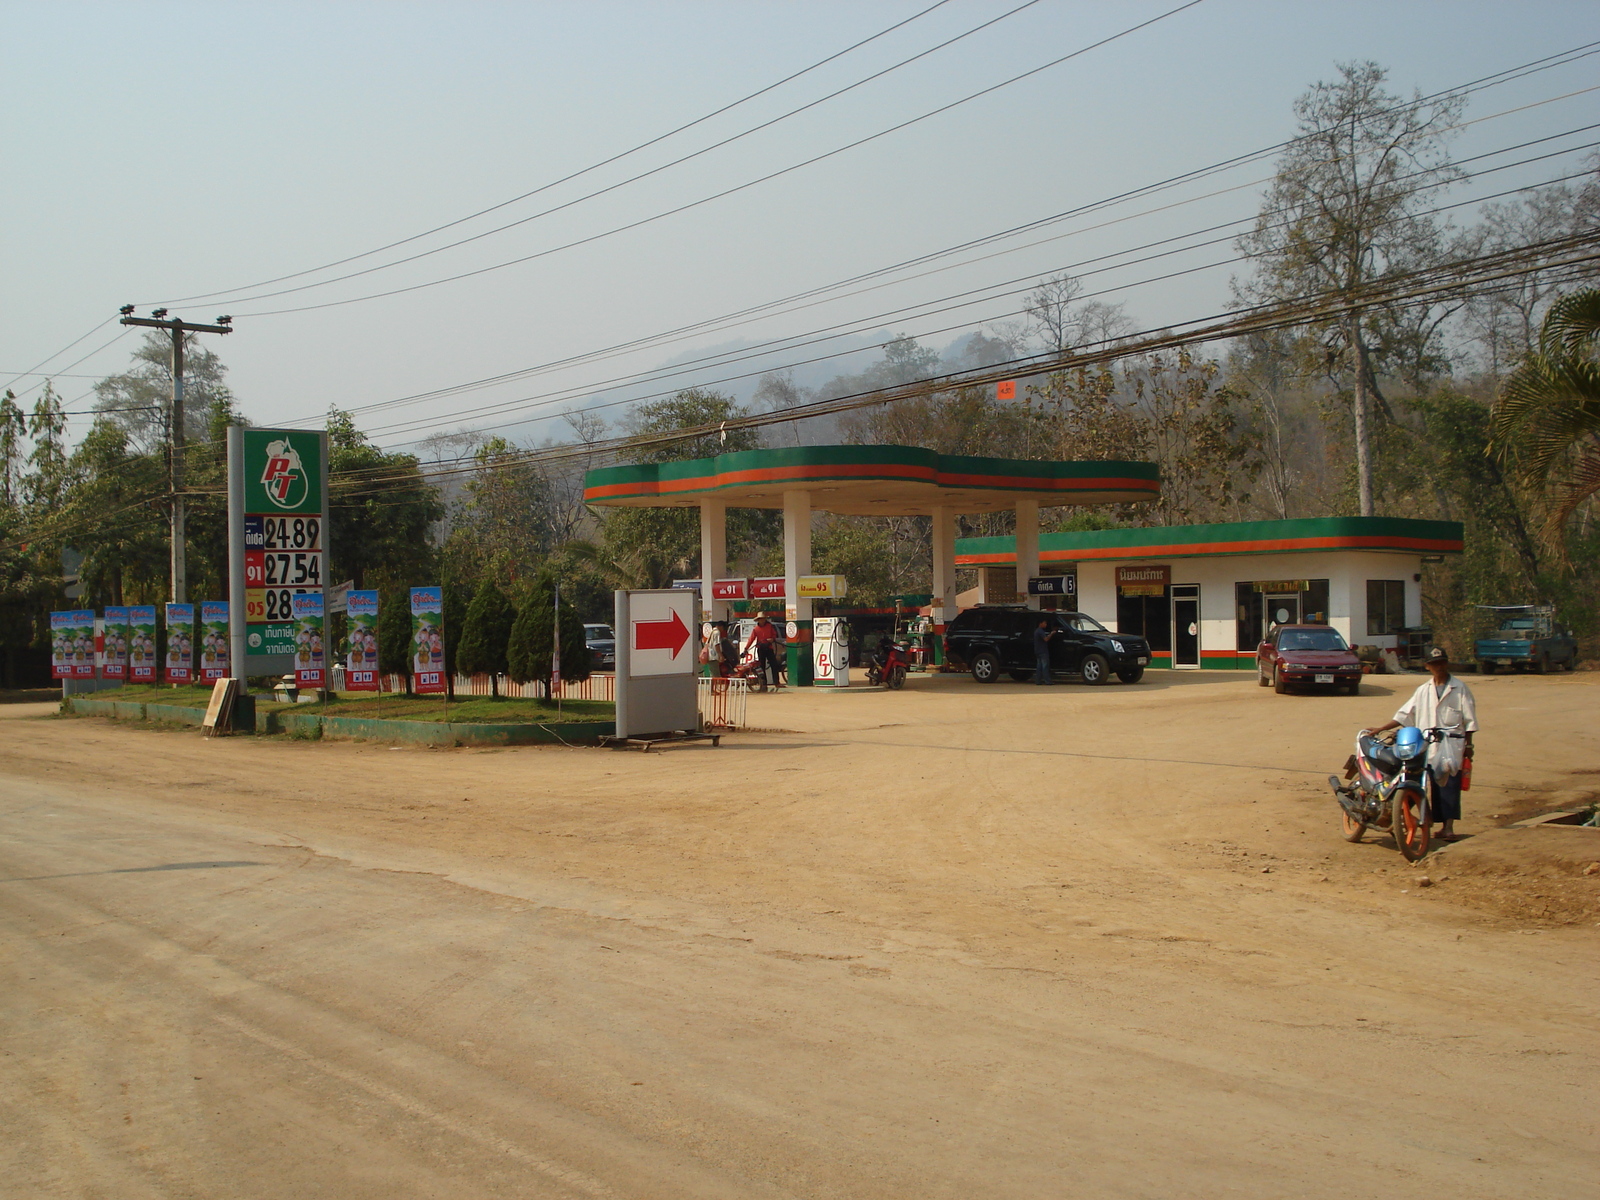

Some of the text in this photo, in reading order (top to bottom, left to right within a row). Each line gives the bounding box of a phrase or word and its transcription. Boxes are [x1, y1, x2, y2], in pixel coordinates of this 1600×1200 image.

[264, 458, 297, 498] PT
[265, 518, 319, 549] 24.89
[247, 565, 261, 581] 91
[265, 554, 320, 585] 27.54
[726, 585, 736, 595] 91
[767, 583, 777, 593] 91
[816, 582, 827, 592] 95
[837, 582, 843, 592] 4
[1068, 580, 1073, 590] 5
[247, 601, 264, 617] 95
[819, 654, 830, 676] PT
